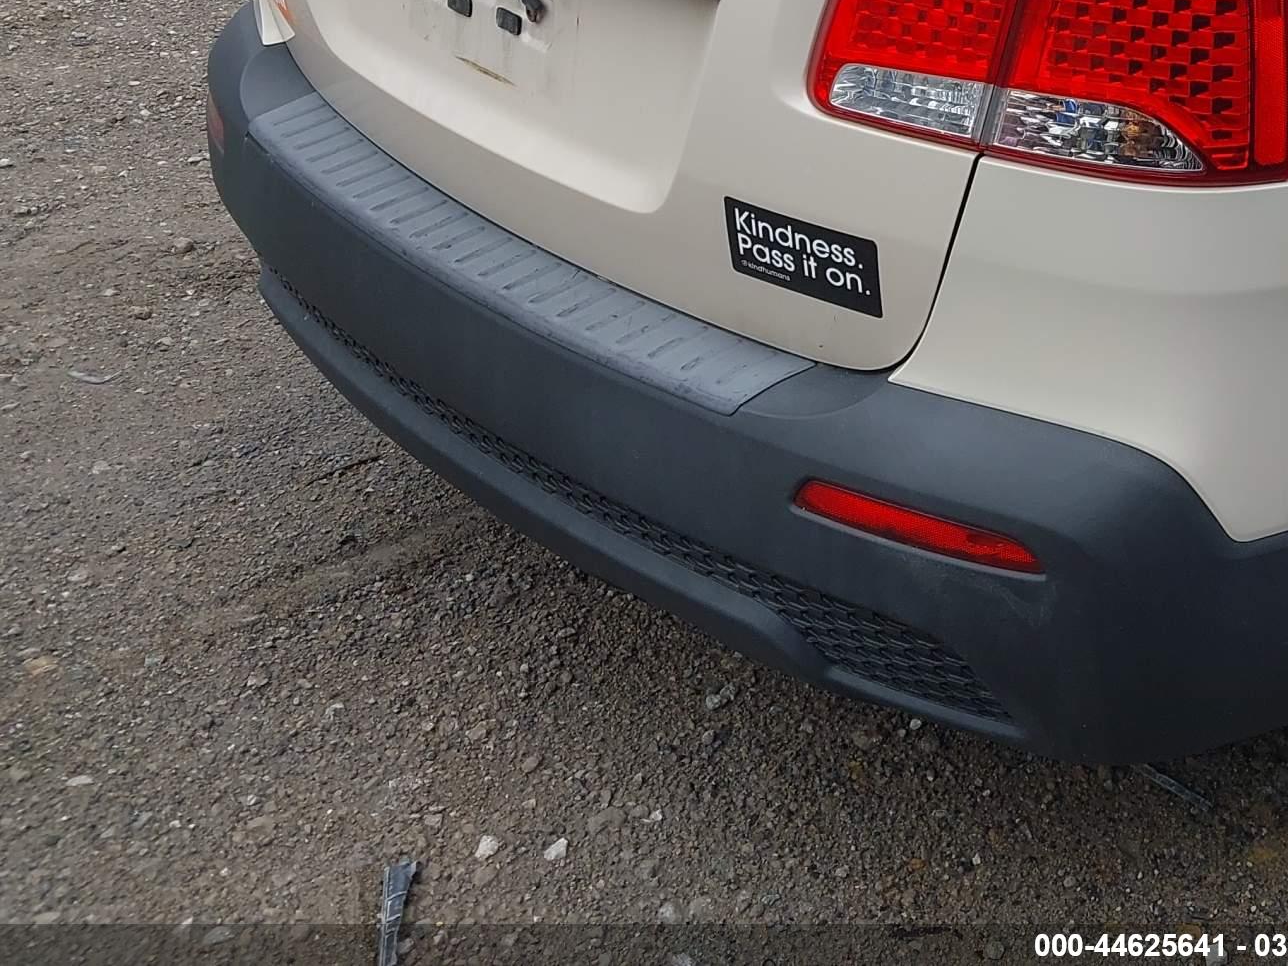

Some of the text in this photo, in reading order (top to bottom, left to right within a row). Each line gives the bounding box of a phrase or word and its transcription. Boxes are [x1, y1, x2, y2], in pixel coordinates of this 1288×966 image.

[734, 208, 864, 269] Kindness.
[737, 234, 871, 296] Pass it on.
